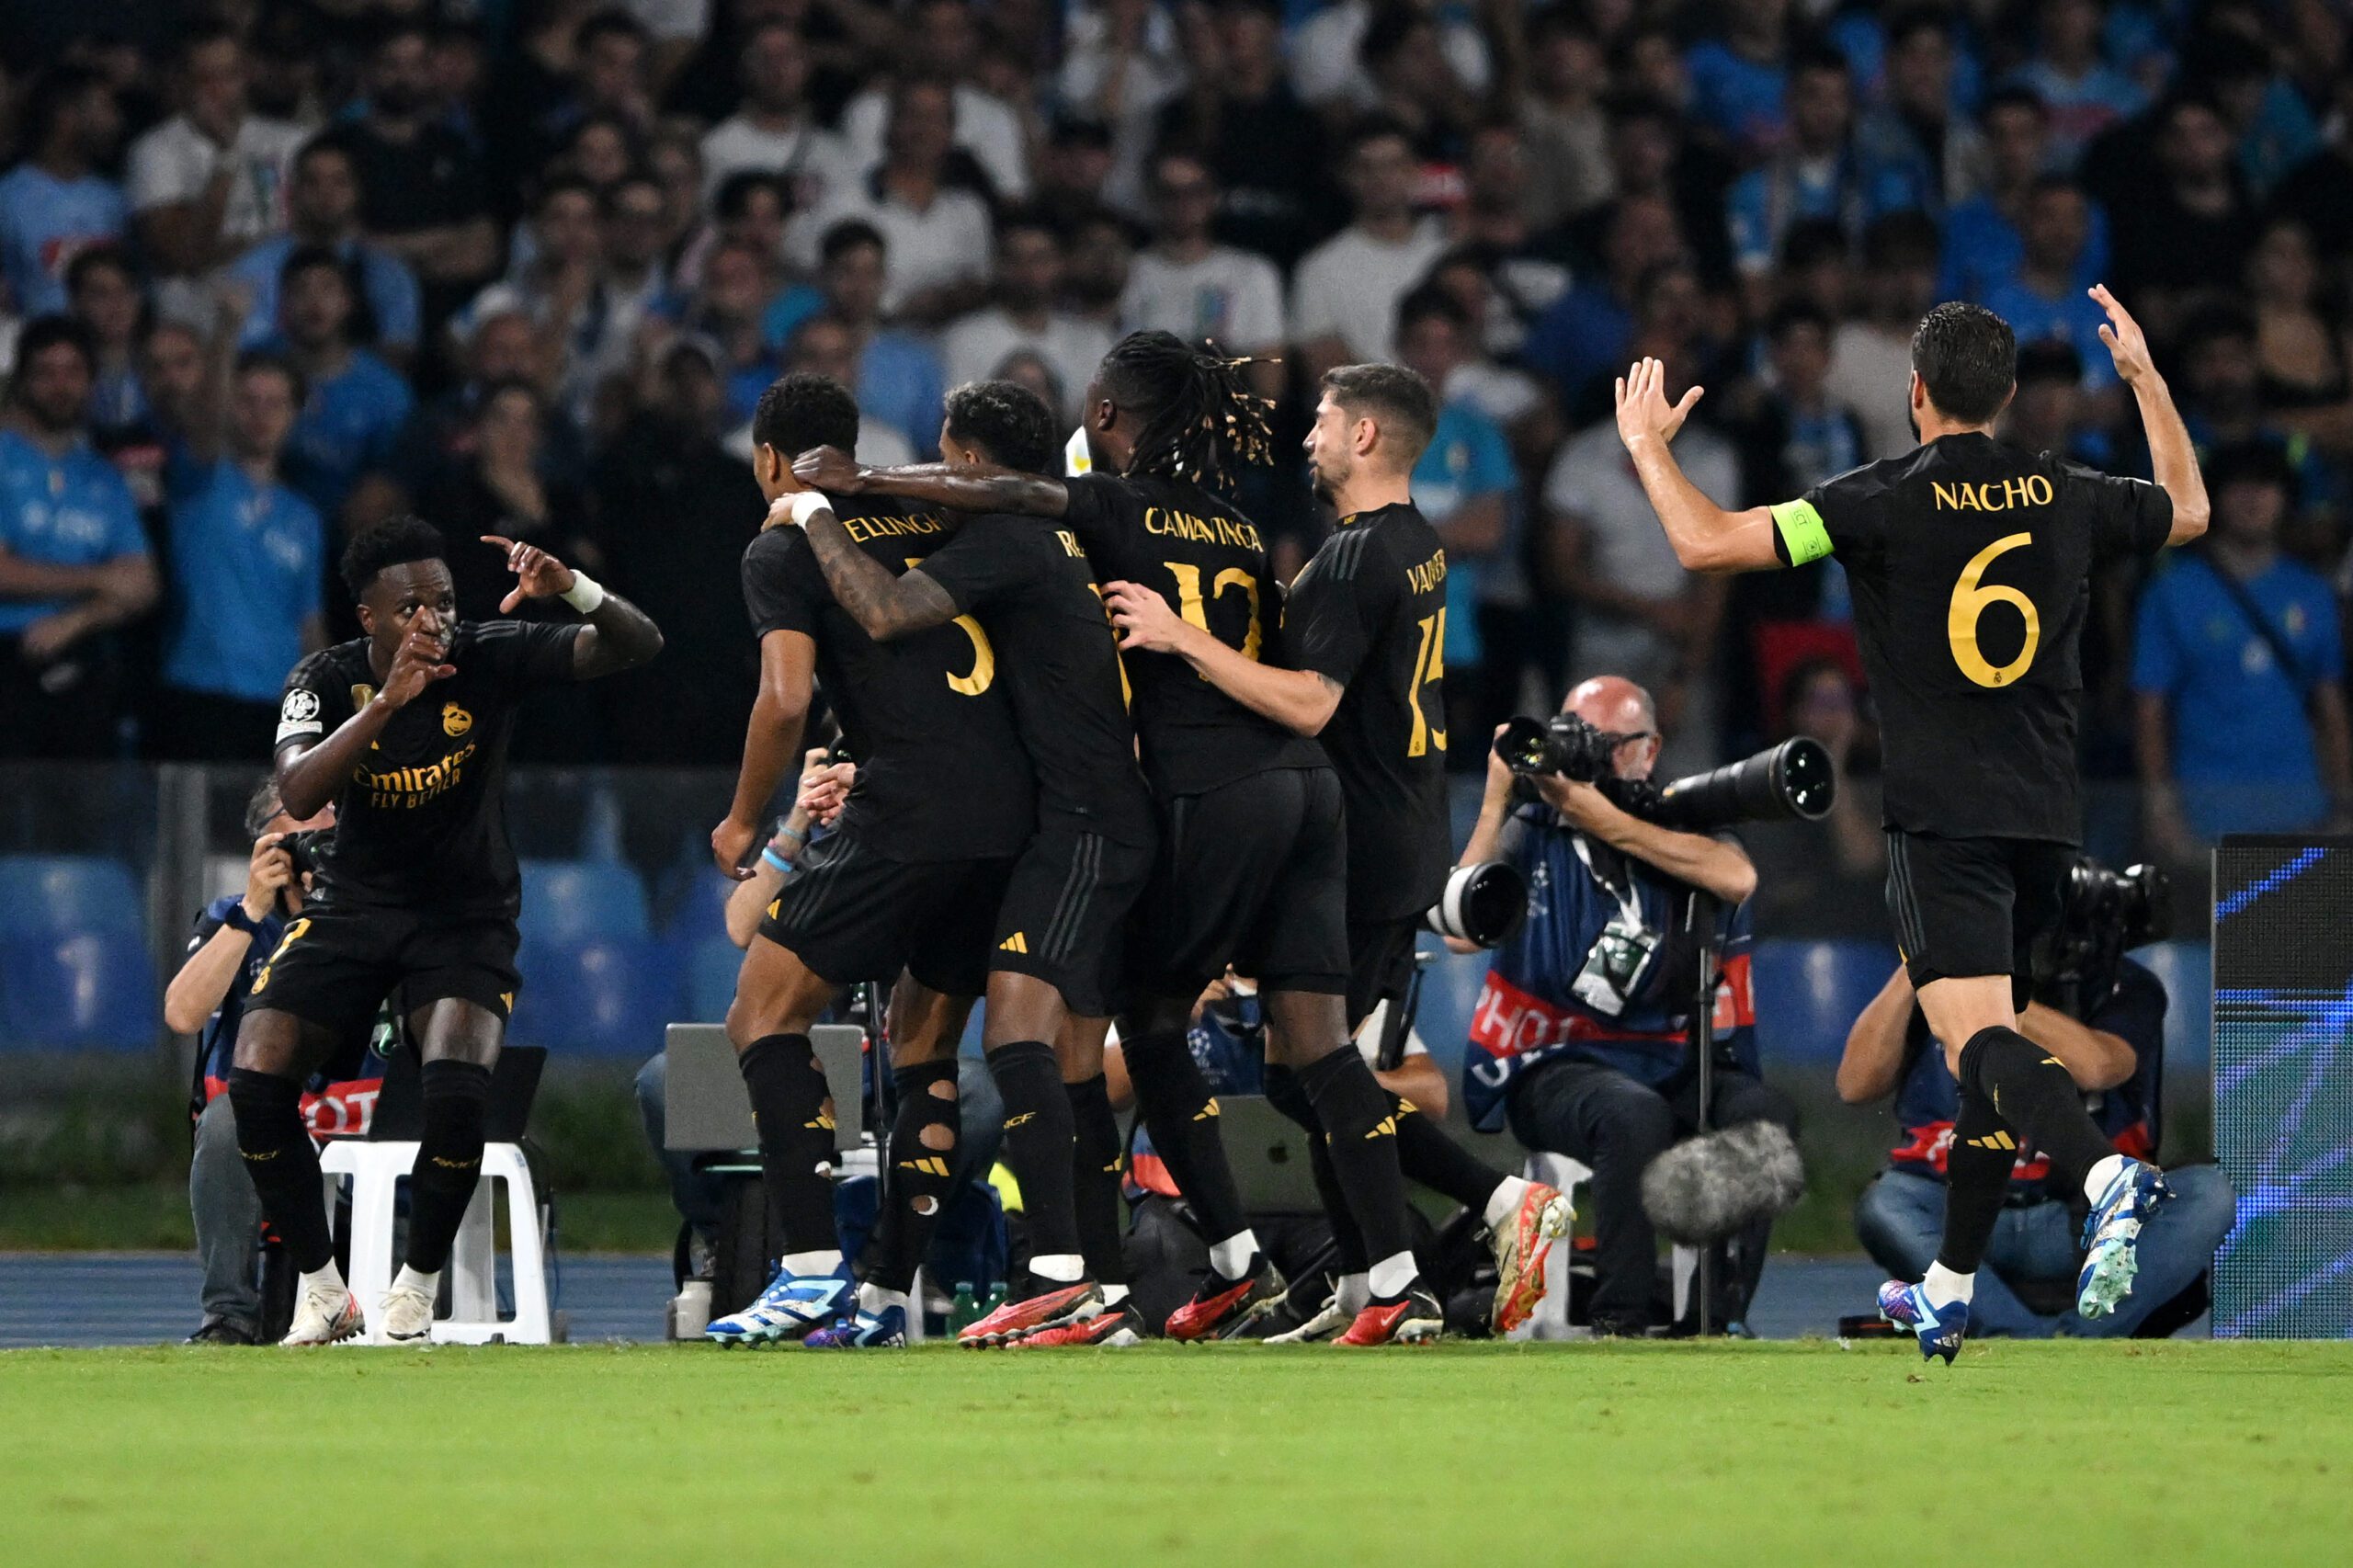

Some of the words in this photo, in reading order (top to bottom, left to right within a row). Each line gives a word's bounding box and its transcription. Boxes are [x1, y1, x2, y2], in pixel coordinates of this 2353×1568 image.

[1931, 474, 2053, 512] NACHO
[1144, 506, 1265, 553] CAMAVINGA
[1948, 532, 2040, 688] 6
[353, 739, 476, 792] Emirates
[371, 792, 401, 808] FLY
[406, 767, 460, 809] BETTER
